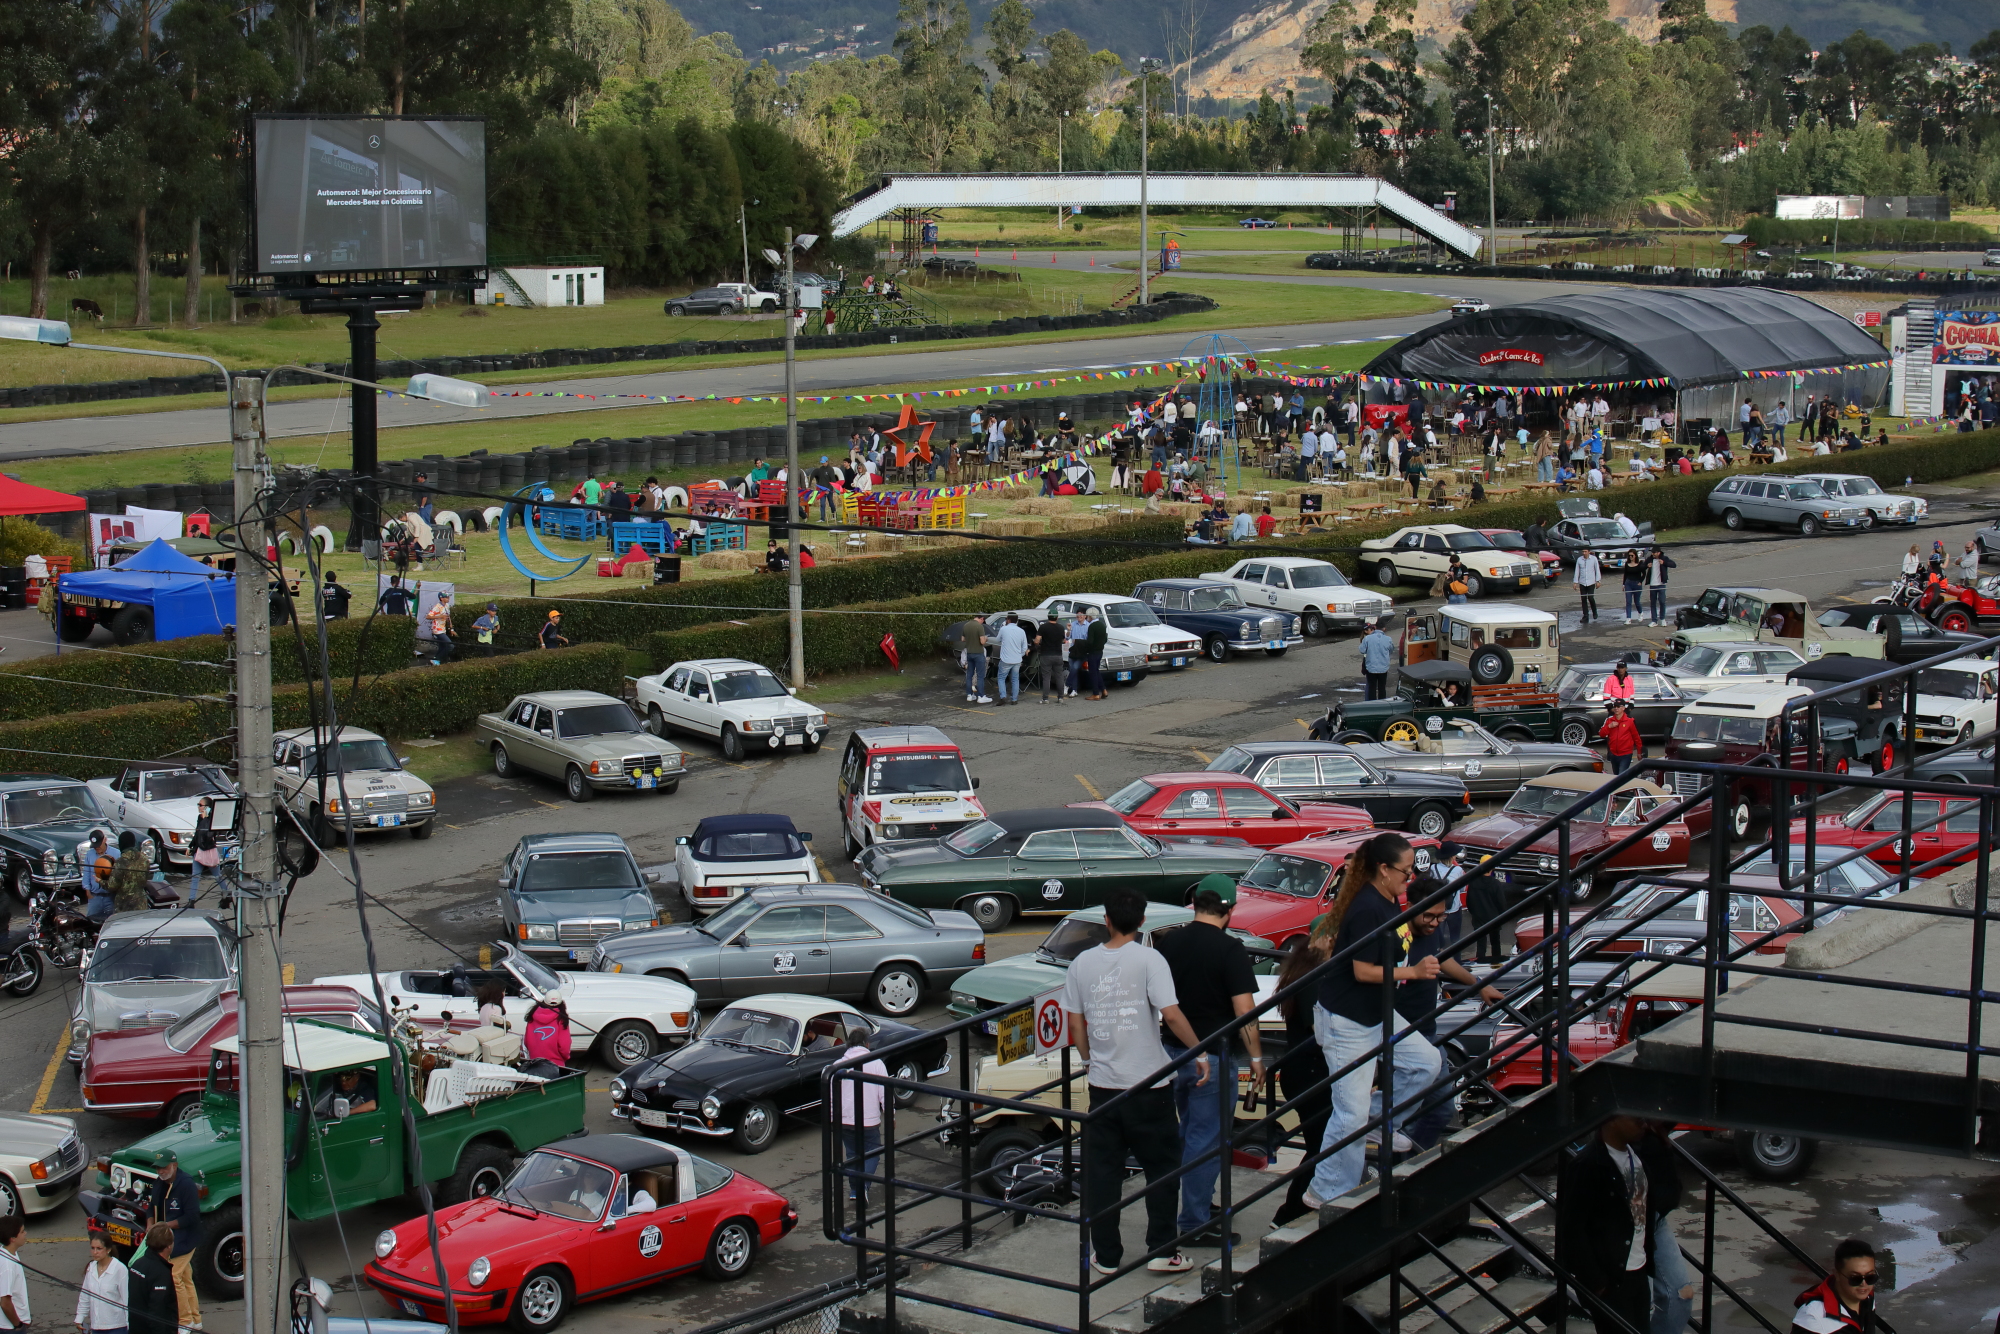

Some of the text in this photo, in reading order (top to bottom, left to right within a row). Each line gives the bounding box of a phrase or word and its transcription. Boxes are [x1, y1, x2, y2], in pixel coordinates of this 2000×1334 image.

[361, 189, 382, 197] Mejor
[383, 188, 431, 196] Concesionario
[1946, 325, 2000, 347] COCINA
[1192, 796, 1208, 805] 299
[1000, 1013, 1024, 1031] TRANSITE
[1006, 1046, 1017, 1059] PISO
[642, 1233, 659, 1249] 160
